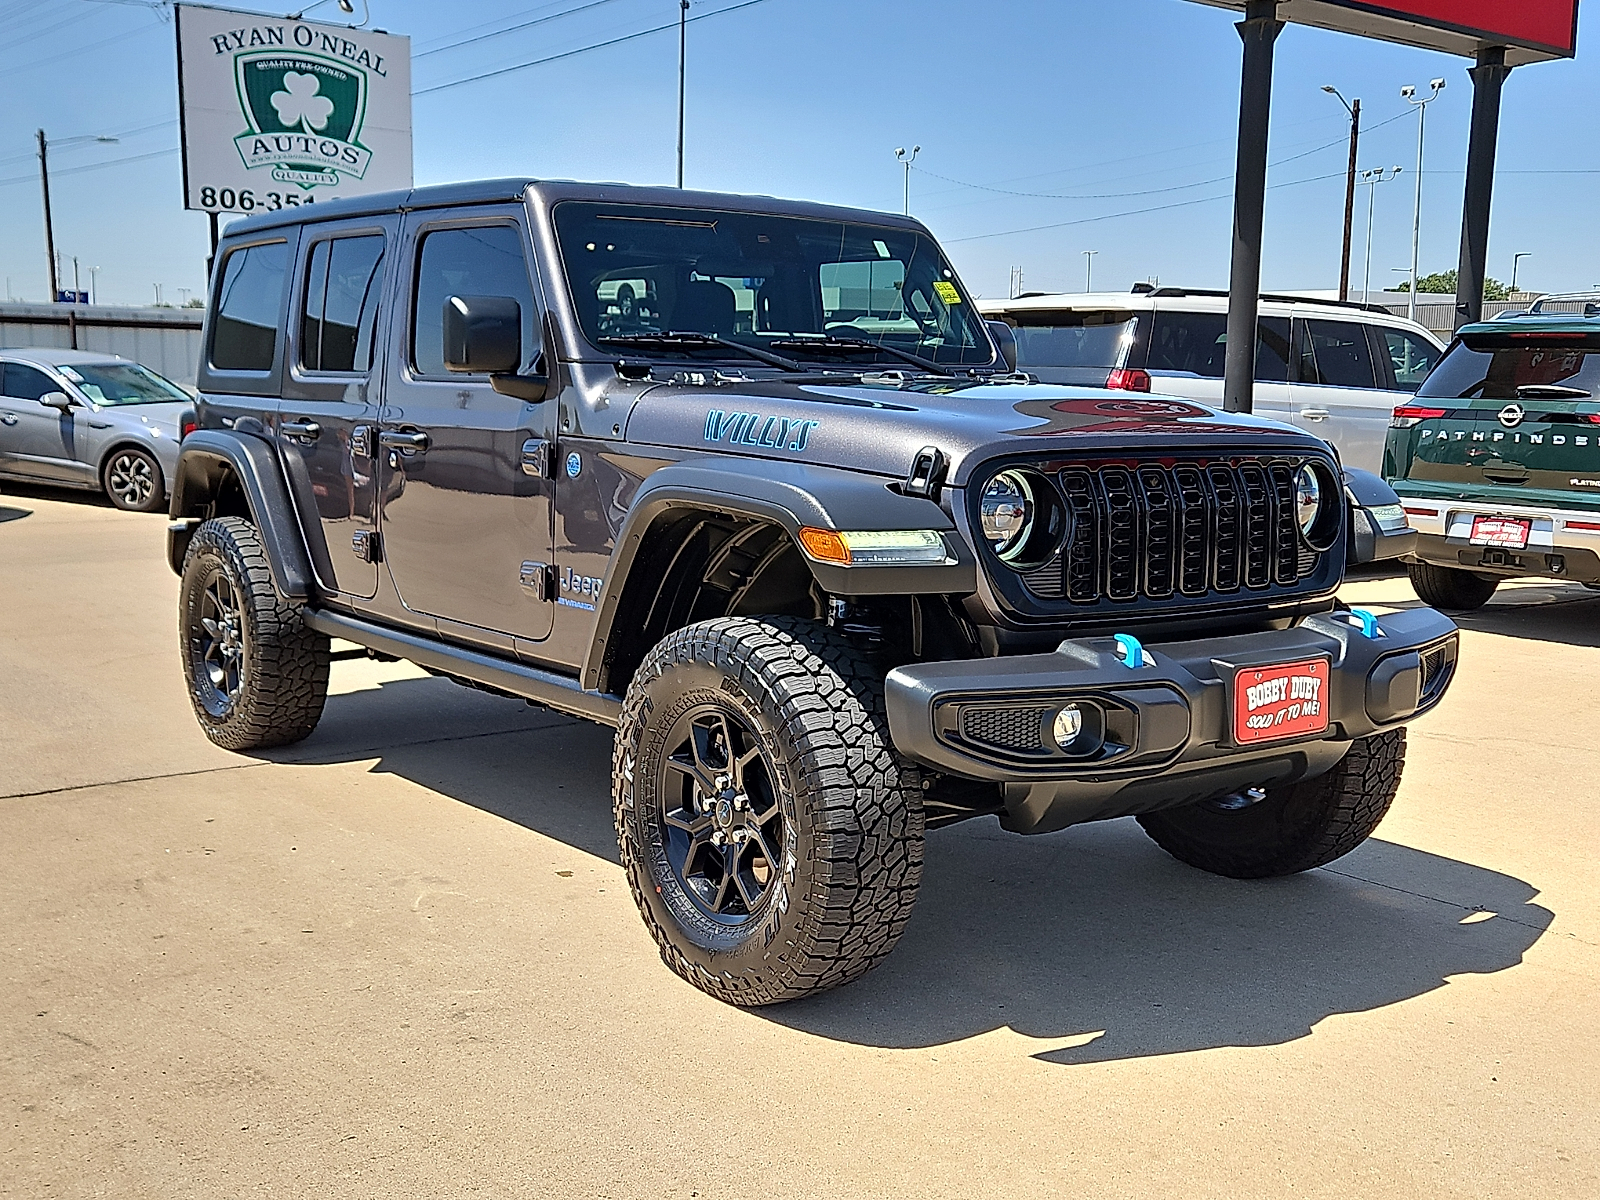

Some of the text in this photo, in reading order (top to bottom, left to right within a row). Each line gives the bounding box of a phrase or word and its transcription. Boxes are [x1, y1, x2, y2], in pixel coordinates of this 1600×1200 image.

[210, 25, 387, 77] RYAN O'NEAL
[252, 136, 360, 164] AUTOS
[275, 171, 335, 183] QUALITY
[703, 409, 820, 451] WILLYS
[1421, 429, 1600, 446] PATHFINDE
[560, 566, 603, 602] Jeep
[1246, 676, 1322, 712] BOBBY DUBY
[1246, 701, 1320, 729] SOLD IT TO ME!
